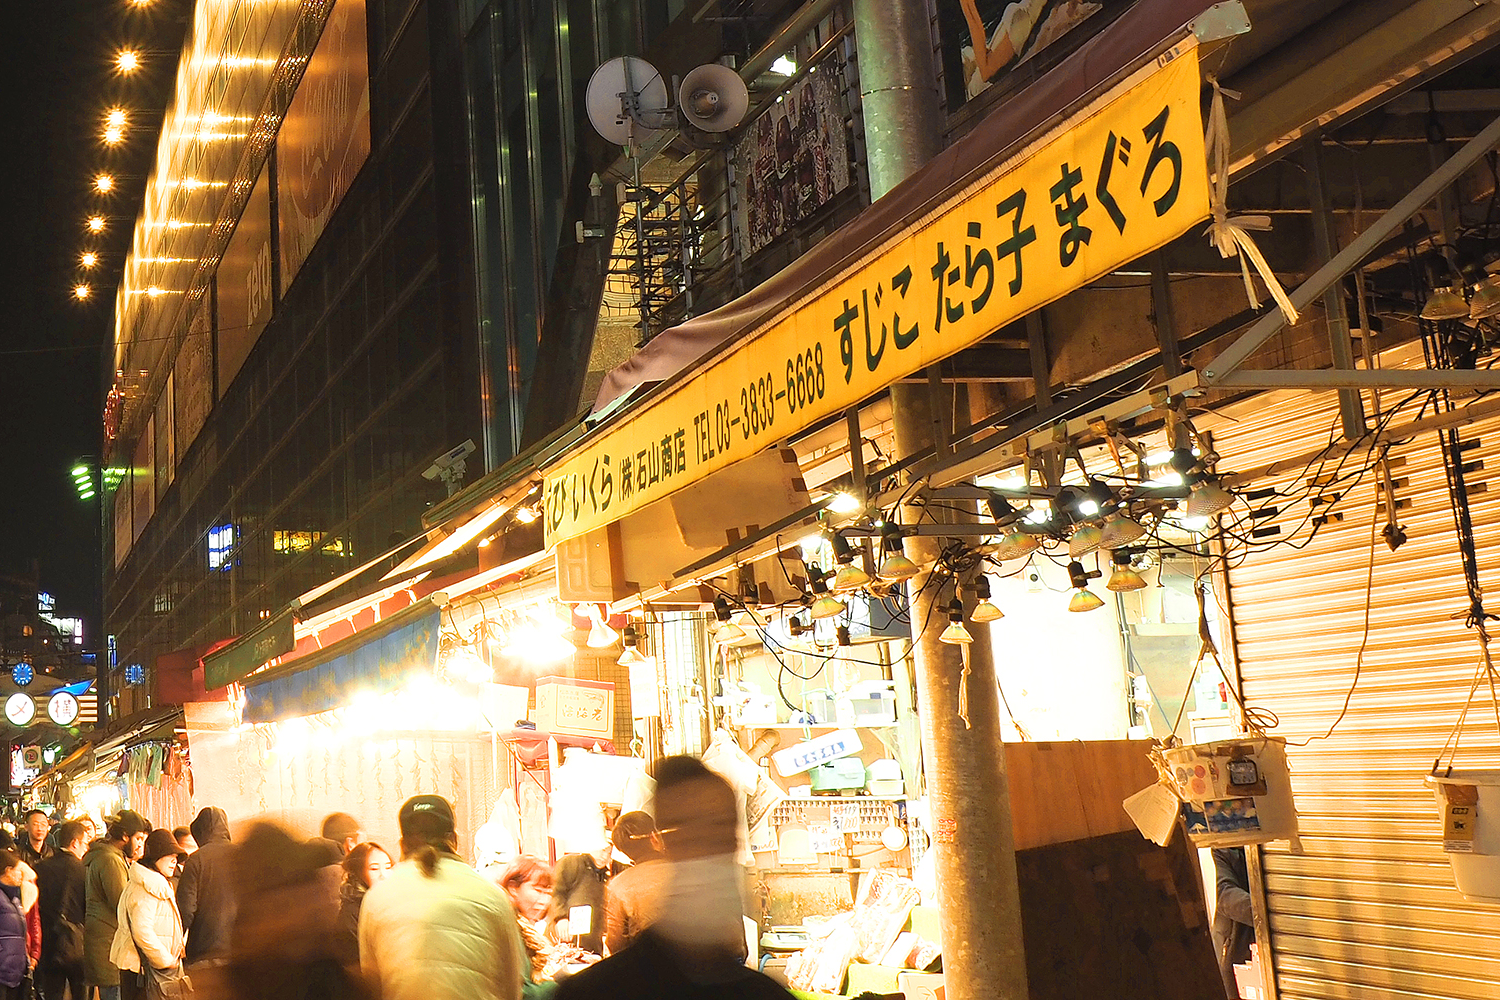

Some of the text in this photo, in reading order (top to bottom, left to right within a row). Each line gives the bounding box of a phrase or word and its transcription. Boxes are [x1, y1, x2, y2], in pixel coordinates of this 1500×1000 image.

[572, 454, 613, 521] いくら
[694, 411, 715, 466] TEL
[716, 341, 825, 455] 03-3833-6668
[833, 264, 919, 385] すじこ
[931, 187, 1038, 333] たら子
[1050, 104, 1183, 268] まぐろ
